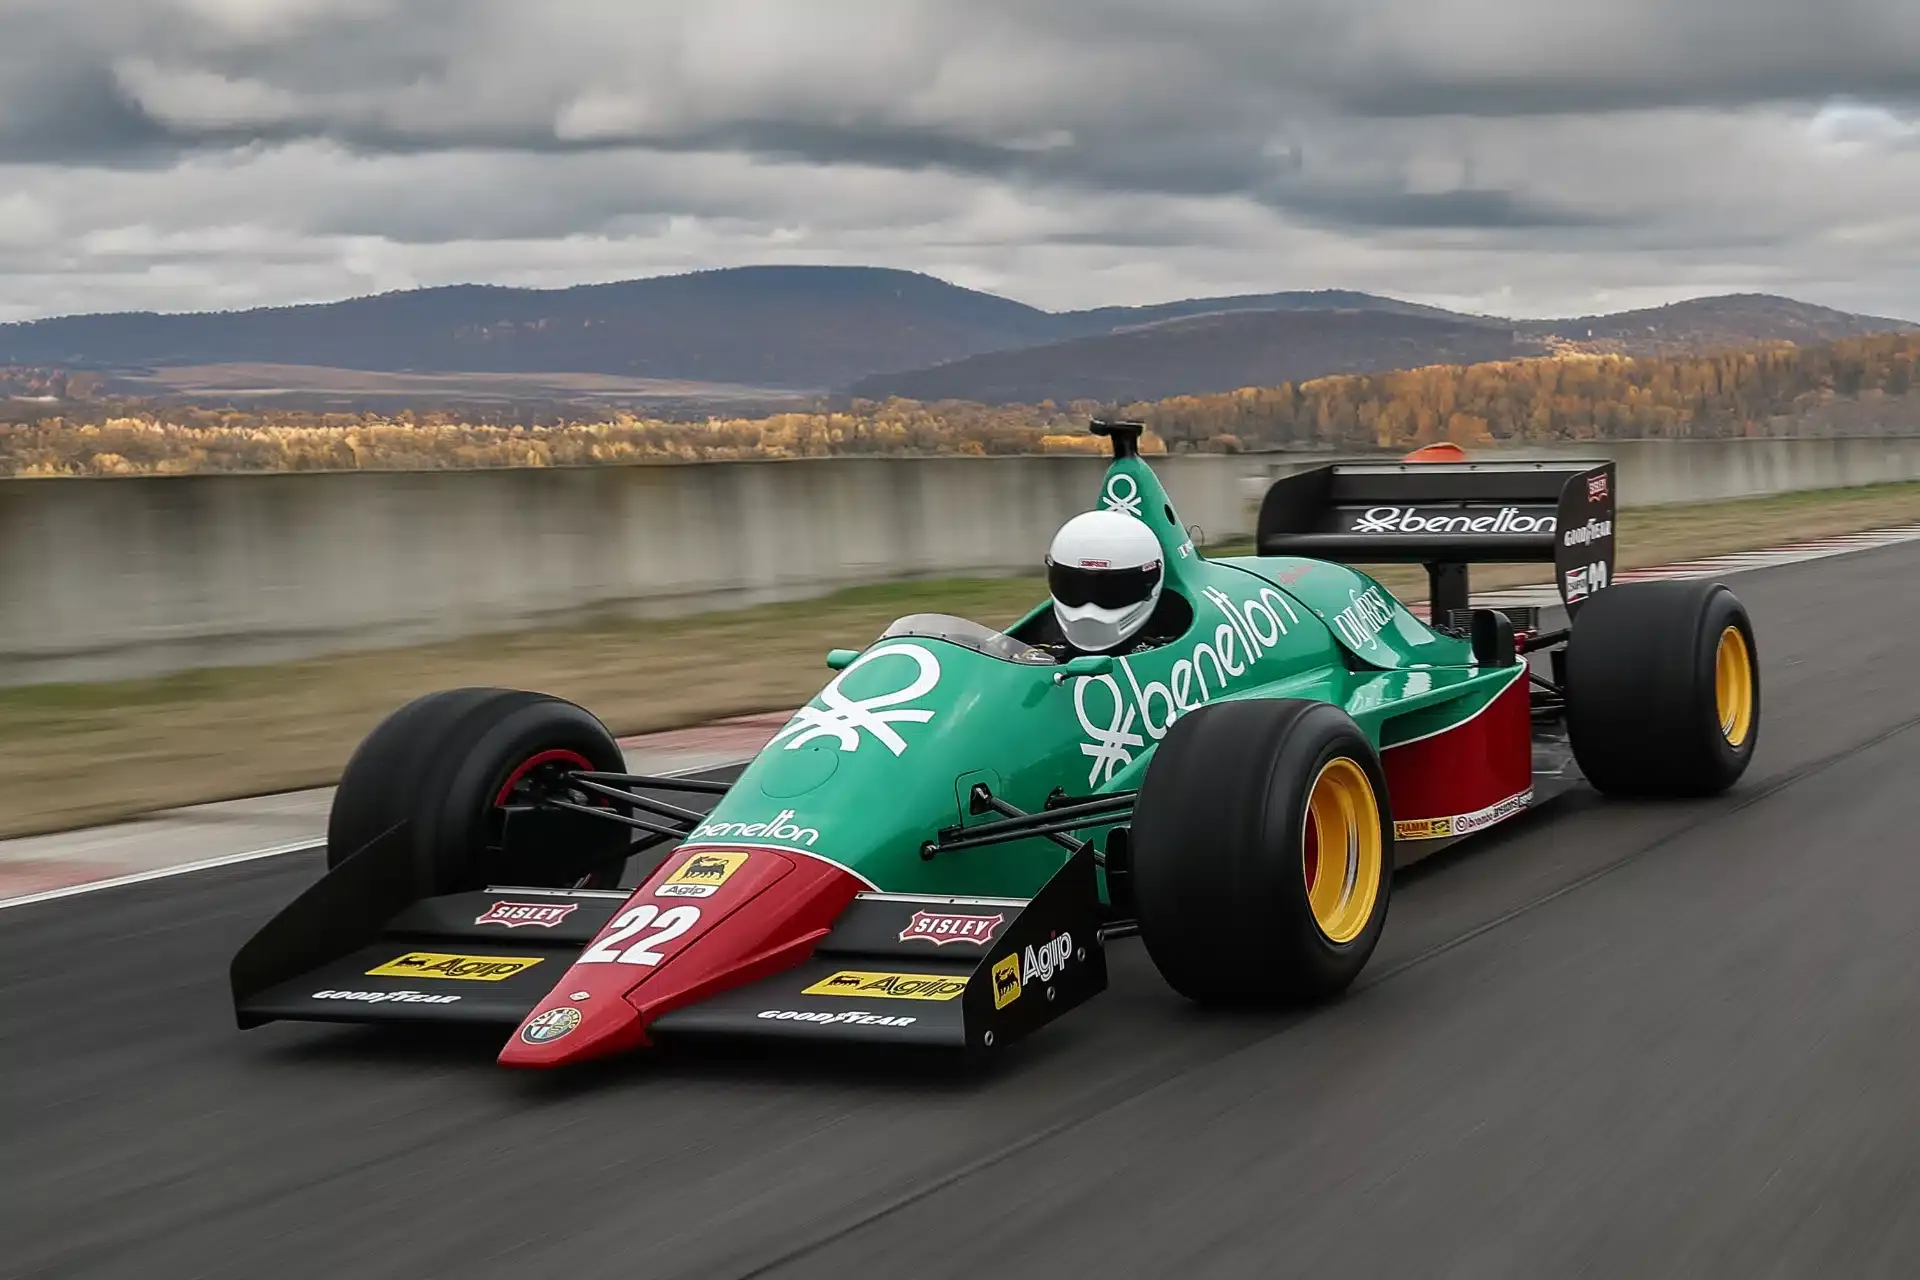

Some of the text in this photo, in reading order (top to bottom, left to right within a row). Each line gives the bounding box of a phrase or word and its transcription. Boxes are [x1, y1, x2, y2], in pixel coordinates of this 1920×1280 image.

[1399, 507, 1557, 533] benetton
[1119, 586, 1300, 739] benetton
[687, 809, 820, 847] benetton
[1396, 821, 1430, 833] FIAMM
[664, 885, 706, 896] Agip
[495, 905, 563, 921] SISLEY
[577, 904, 700, 967] 22
[914, 917, 990, 936] SISLEY
[425, 957, 525, 979] Agip
[1021, 928, 1072, 987] Agip
[311, 989, 462, 1005] GOODYEAR
[859, 975, 966, 997] Agip
[757, 1009, 918, 1027] GOODYEAR
